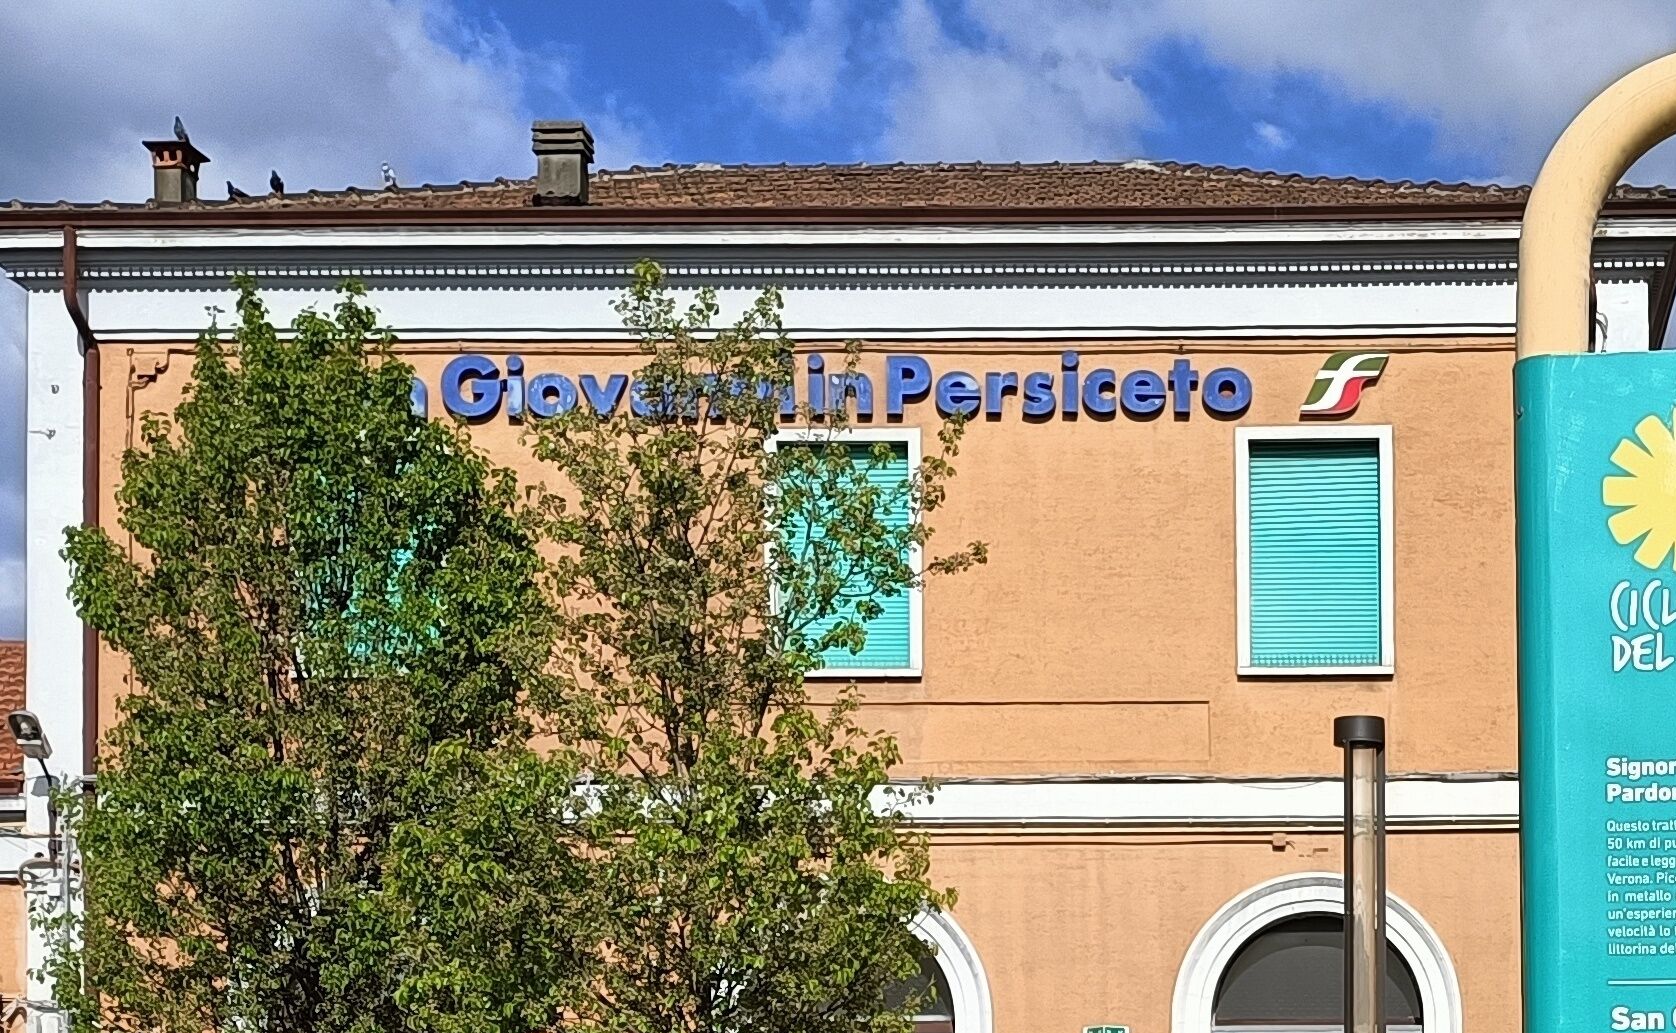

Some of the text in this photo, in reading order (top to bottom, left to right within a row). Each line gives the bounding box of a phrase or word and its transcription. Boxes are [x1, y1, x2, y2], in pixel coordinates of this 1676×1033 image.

[807, 353, 873, 419] in
[885, 350, 1253, 421] Persiceto
[1611, 632, 1675, 672] DEL
[1607, 820, 1649, 832] Questo
[1612, 1007, 1664, 1030] San
